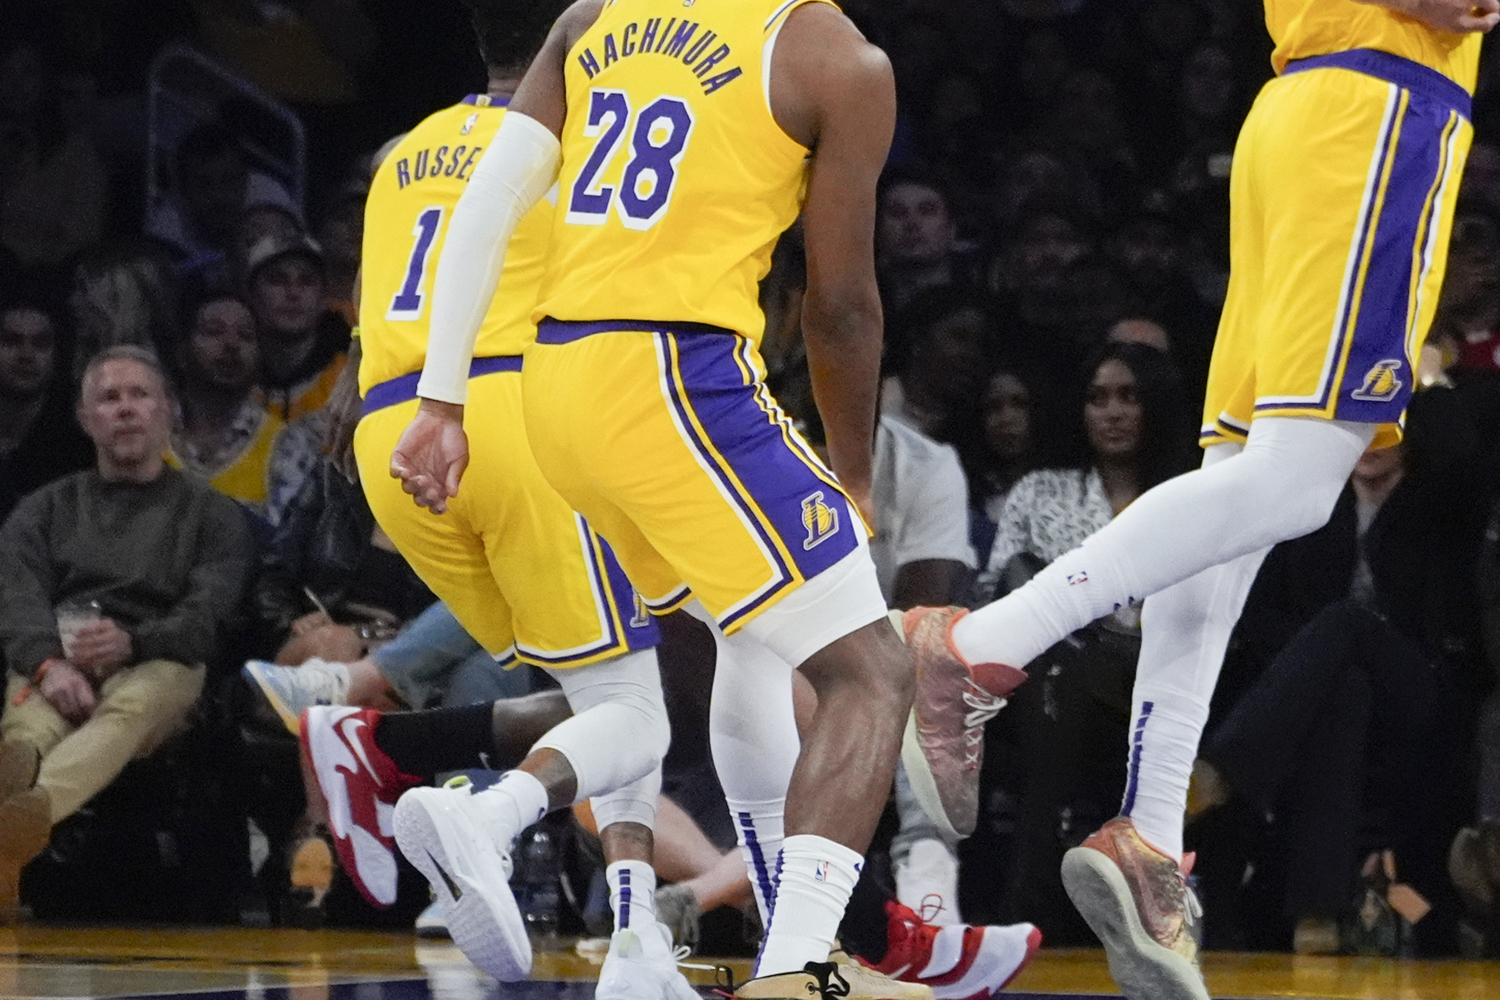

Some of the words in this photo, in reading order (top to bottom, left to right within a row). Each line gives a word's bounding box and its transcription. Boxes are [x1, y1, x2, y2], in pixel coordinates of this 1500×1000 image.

[577, 17, 744, 96] HACHIMURA
[396, 145, 482, 191] RUSSE
[564, 87, 696, 232] 28
[385, 205, 446, 322] 1
